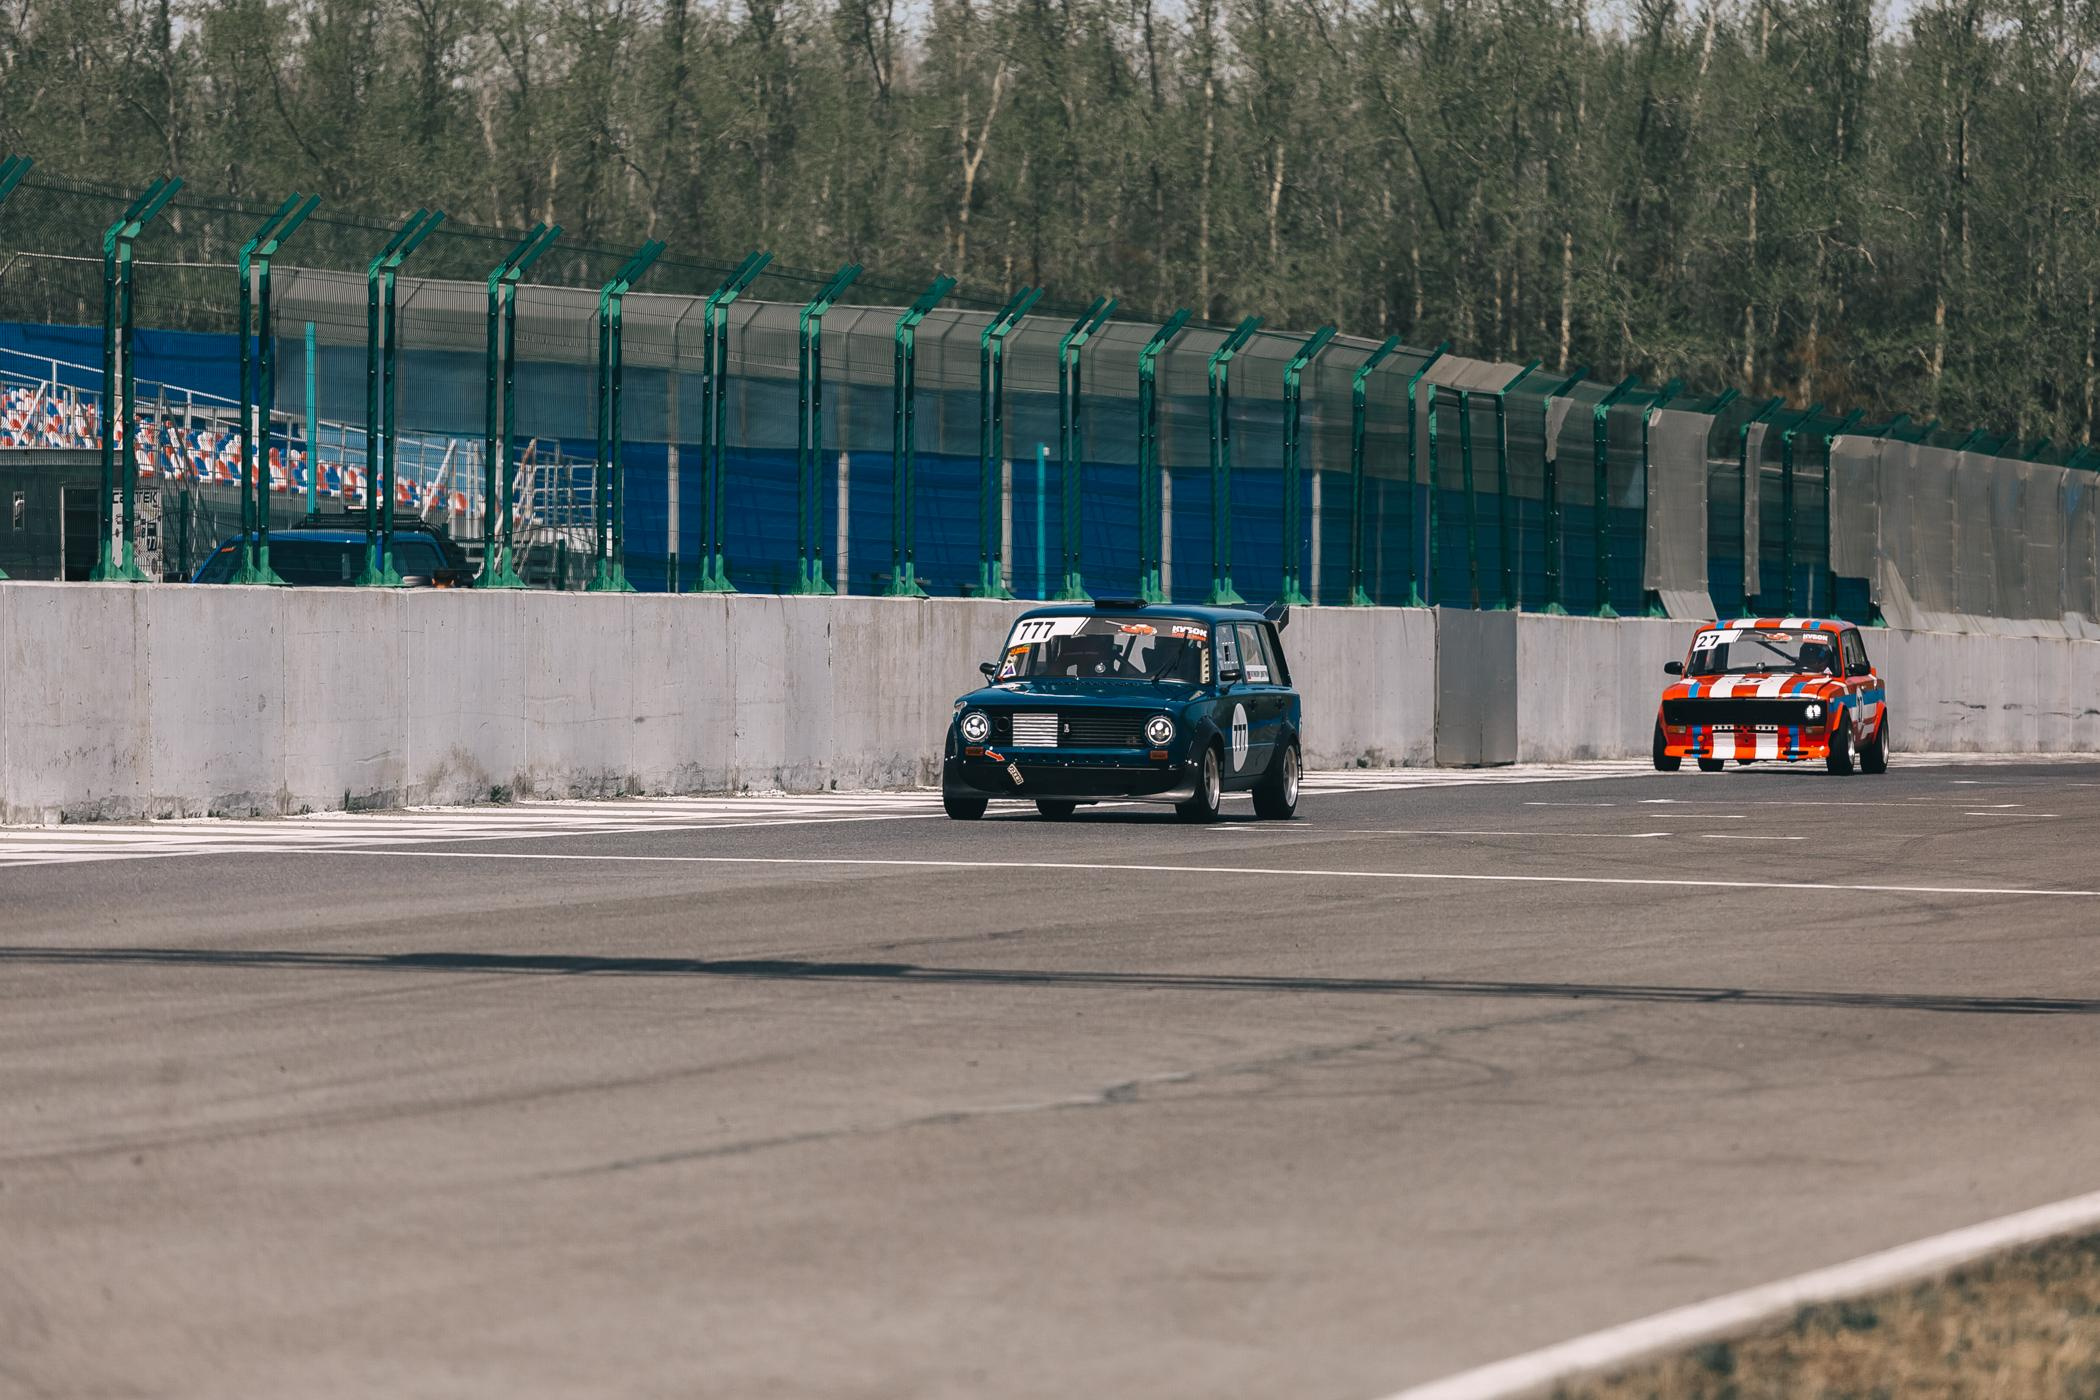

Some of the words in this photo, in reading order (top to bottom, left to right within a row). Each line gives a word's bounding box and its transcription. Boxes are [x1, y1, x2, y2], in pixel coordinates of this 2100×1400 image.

[1021, 621, 1056, 640] 777
[1697, 634, 1720, 648] 27
[1233, 723, 1247, 752] 777
